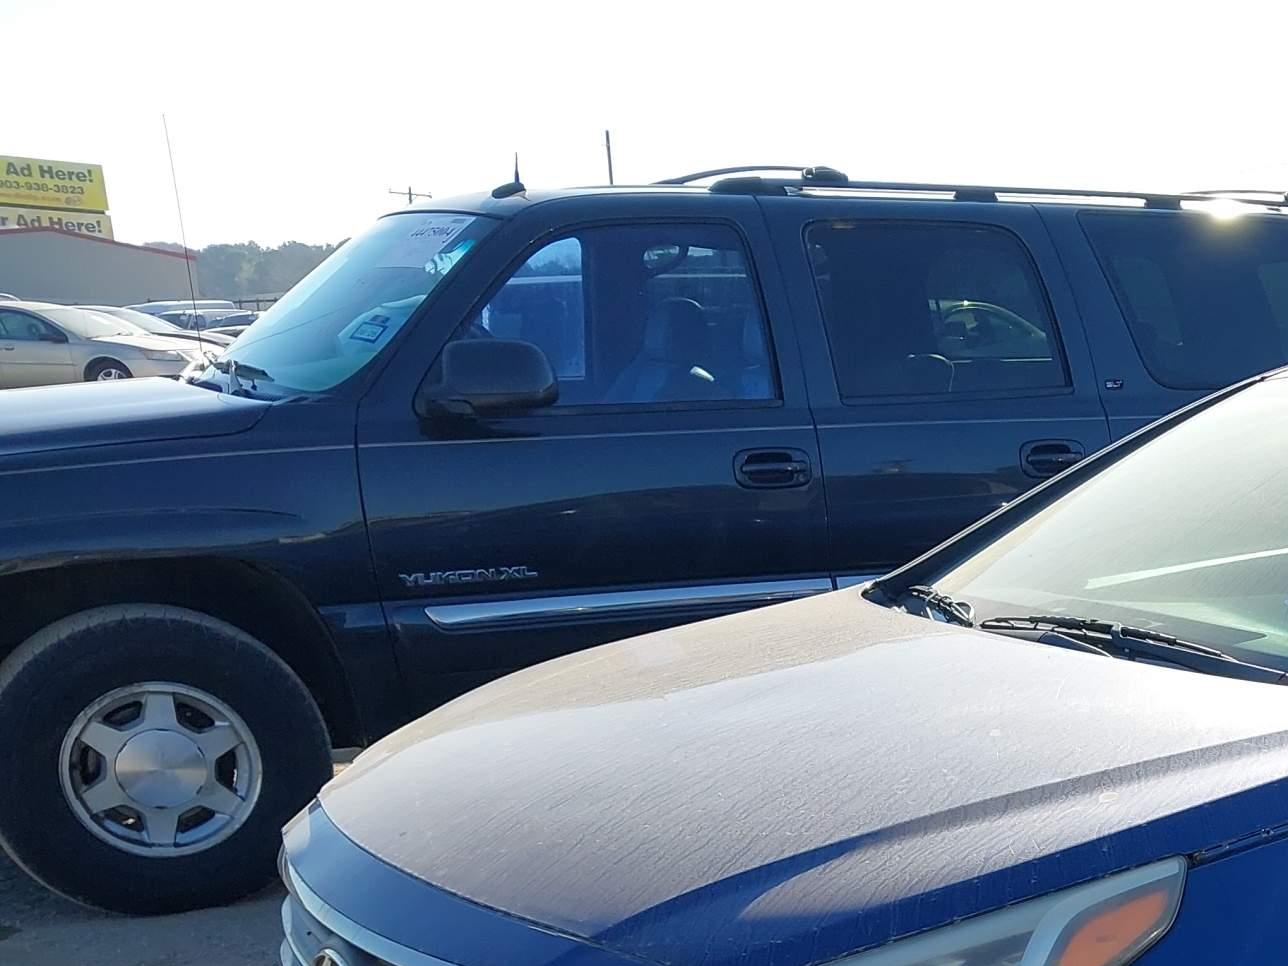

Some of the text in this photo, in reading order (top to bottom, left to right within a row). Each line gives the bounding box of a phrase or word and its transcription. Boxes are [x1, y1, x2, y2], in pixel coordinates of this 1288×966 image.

[6, 162, 94, 183] Ad Here!
[48, 216, 103, 234] Here!
[399, 566, 538, 587] YUKON XL
